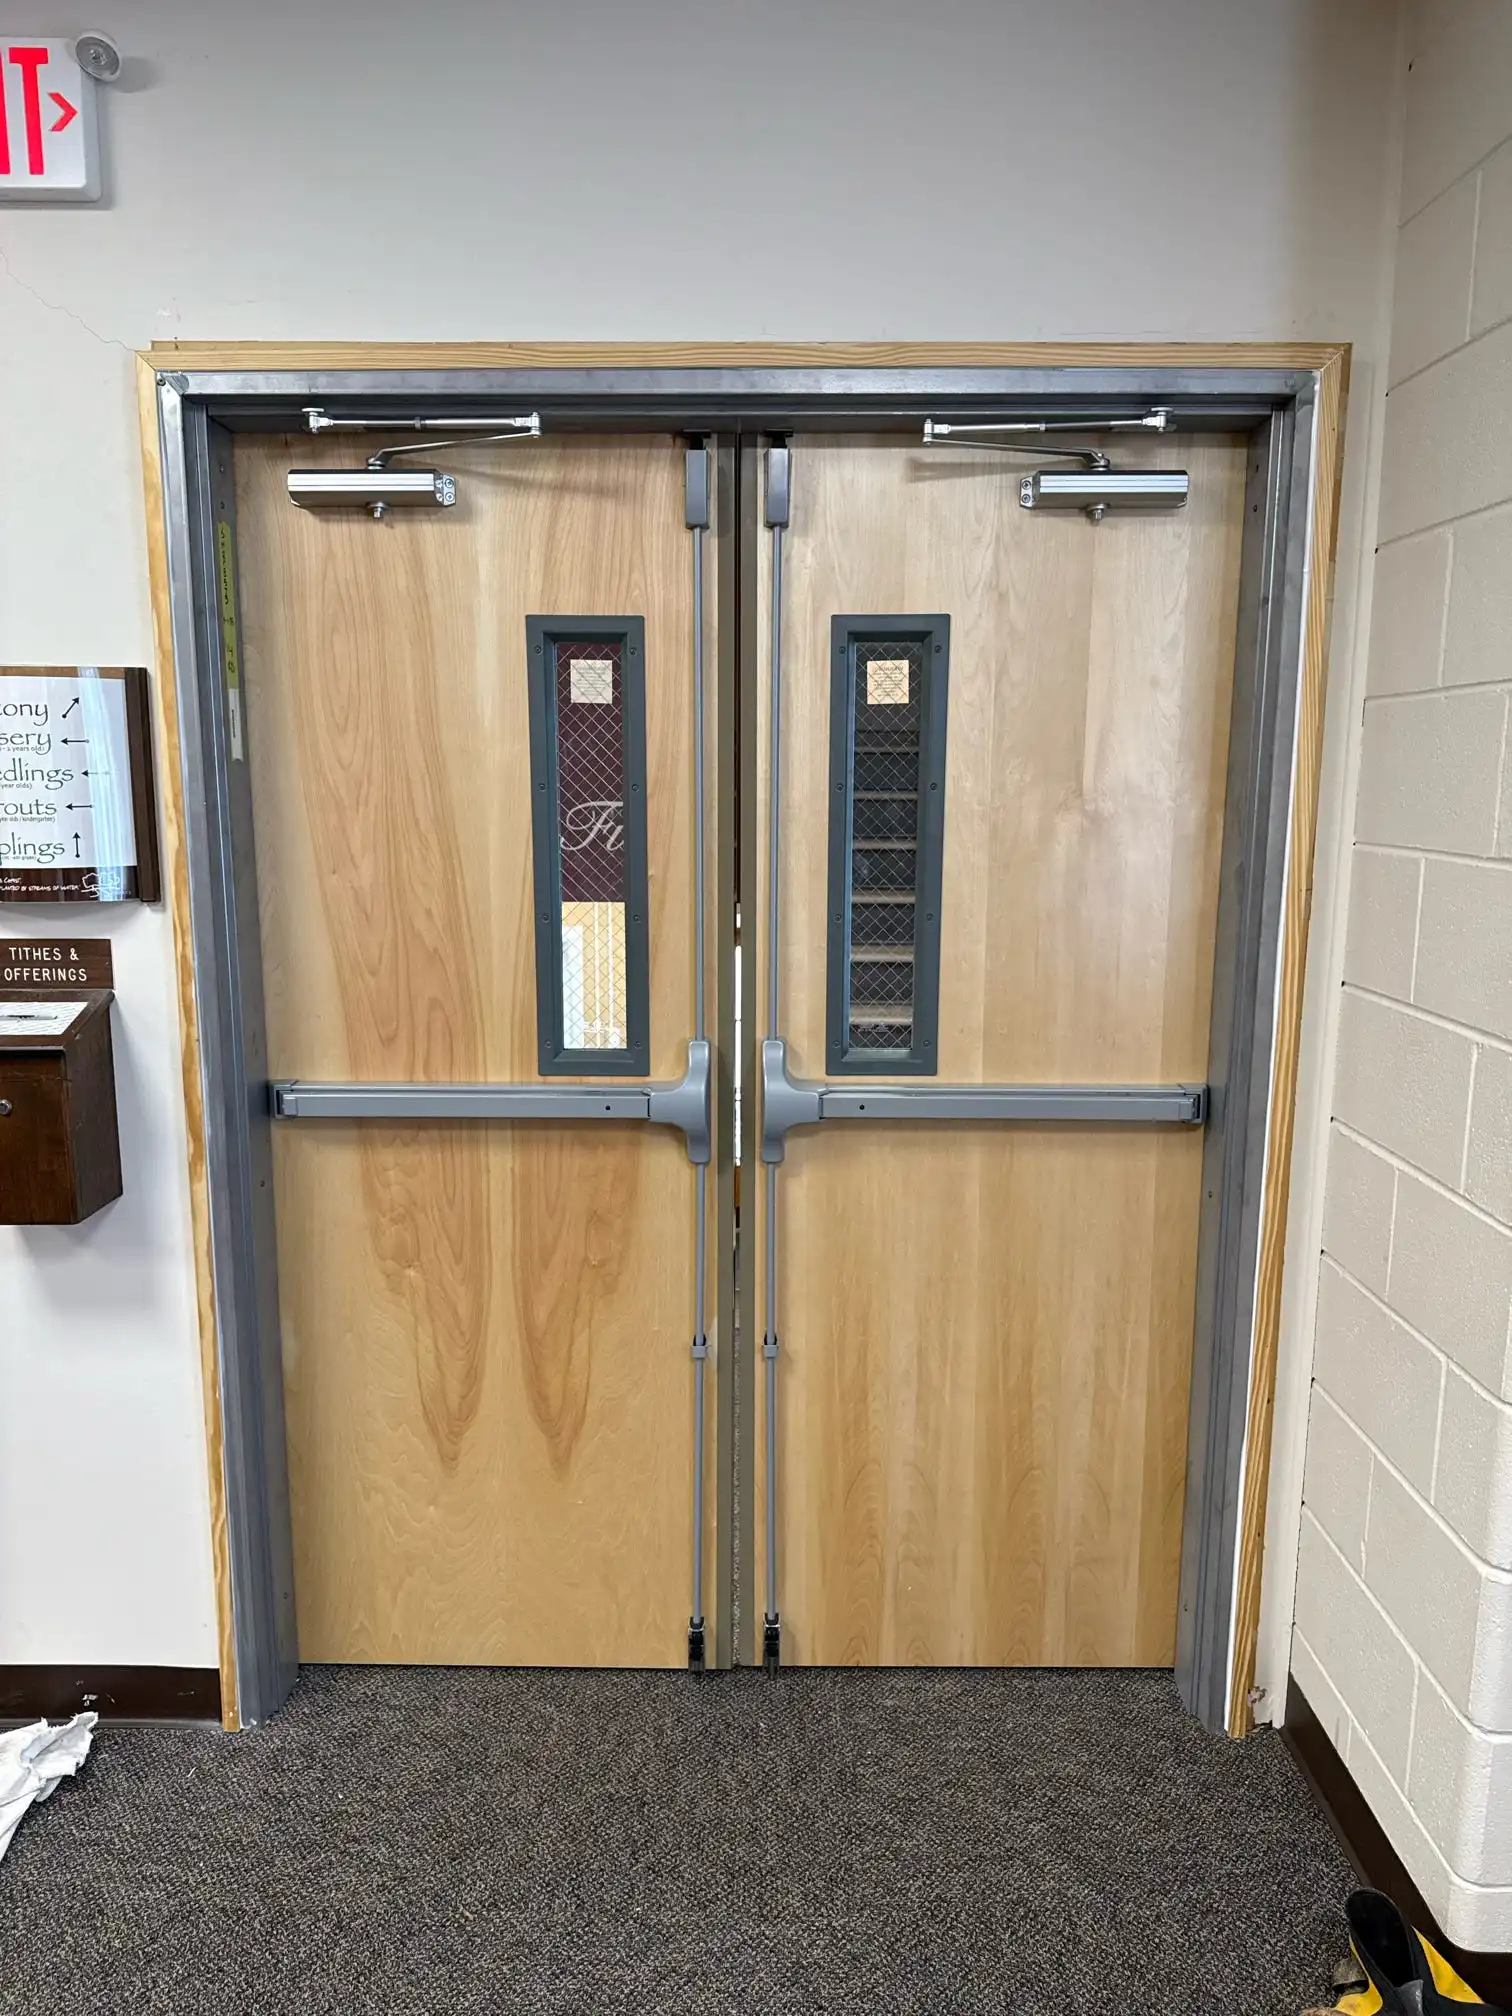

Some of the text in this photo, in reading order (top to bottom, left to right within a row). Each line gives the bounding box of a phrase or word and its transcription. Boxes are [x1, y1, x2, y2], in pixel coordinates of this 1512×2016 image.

[0, 703, 48, 727] ony
[0, 757, 74, 790] dlings
[8, 947, 80, 961] TITHES &
[4, 967, 88, 982] OFFERINGS
